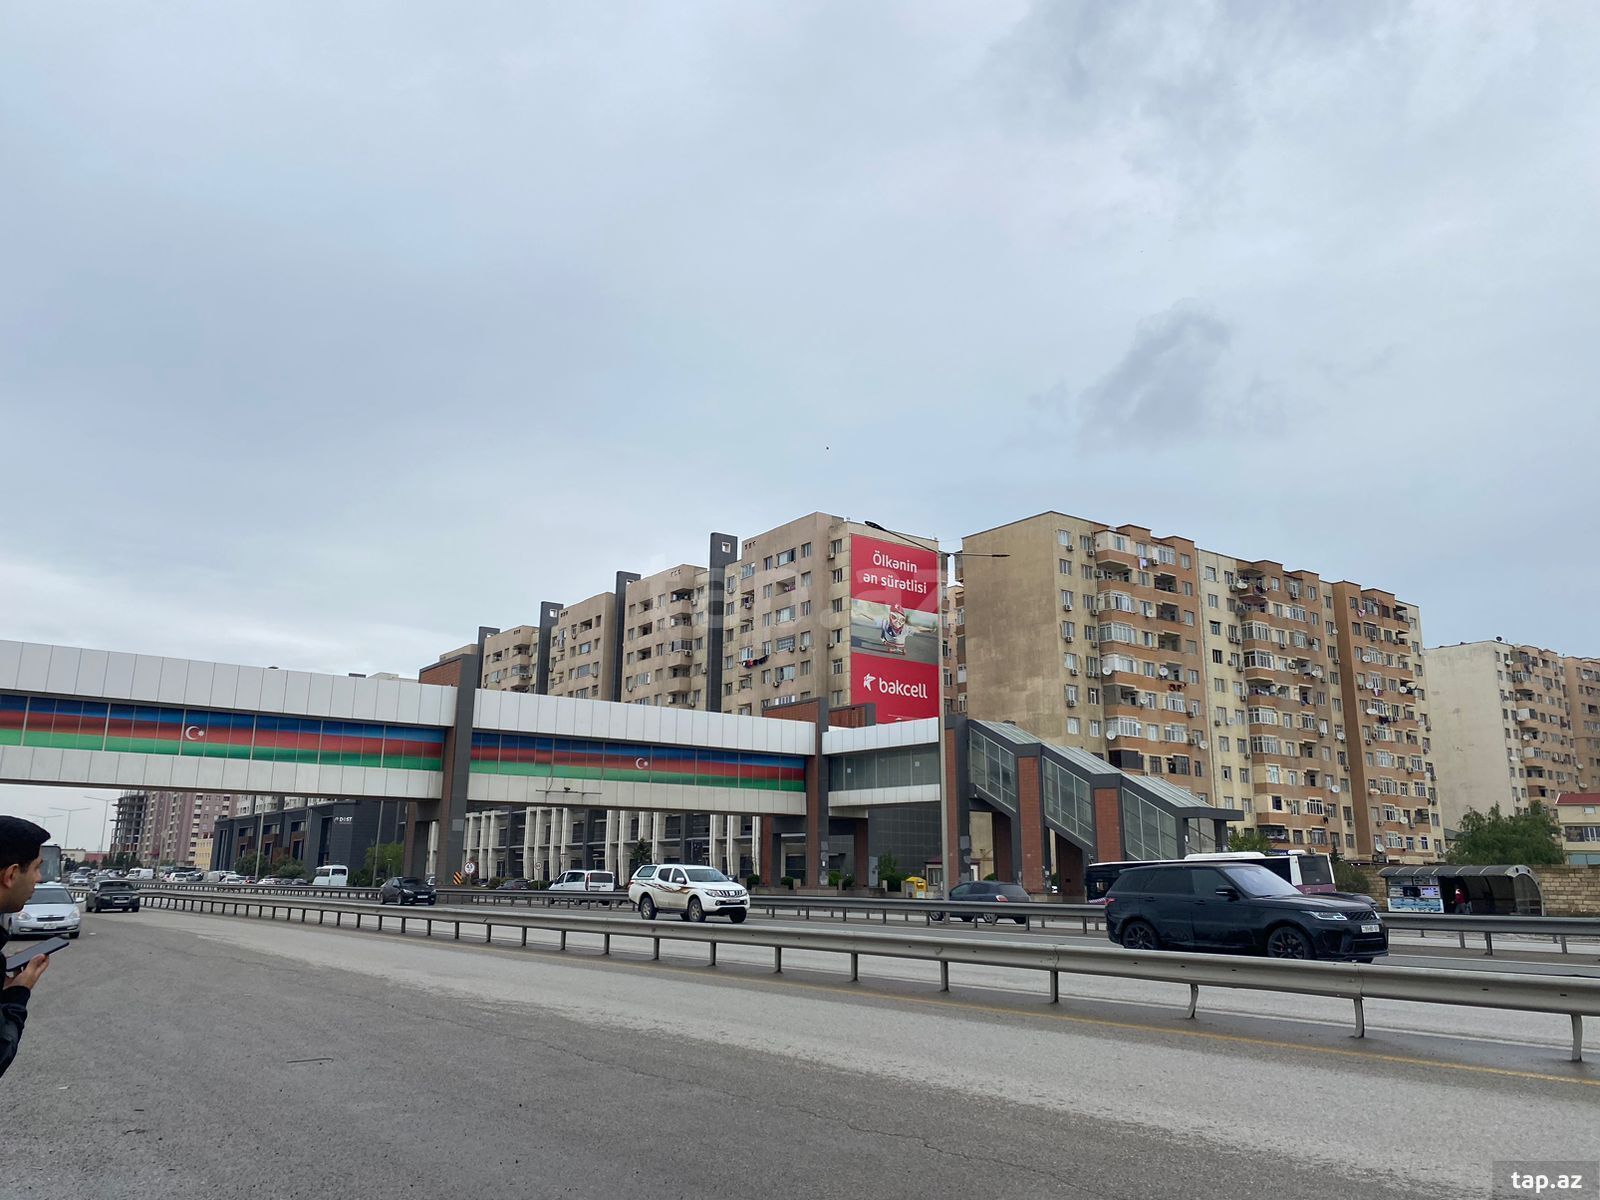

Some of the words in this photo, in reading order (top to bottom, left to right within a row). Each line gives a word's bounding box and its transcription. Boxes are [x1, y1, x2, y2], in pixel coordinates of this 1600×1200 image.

[873, 550, 917, 573] Ölkənin
[863, 573, 878, 585] ən
[881, 574, 927, 594] sürətlisi
[879, 677, 928, 699] bakcell
